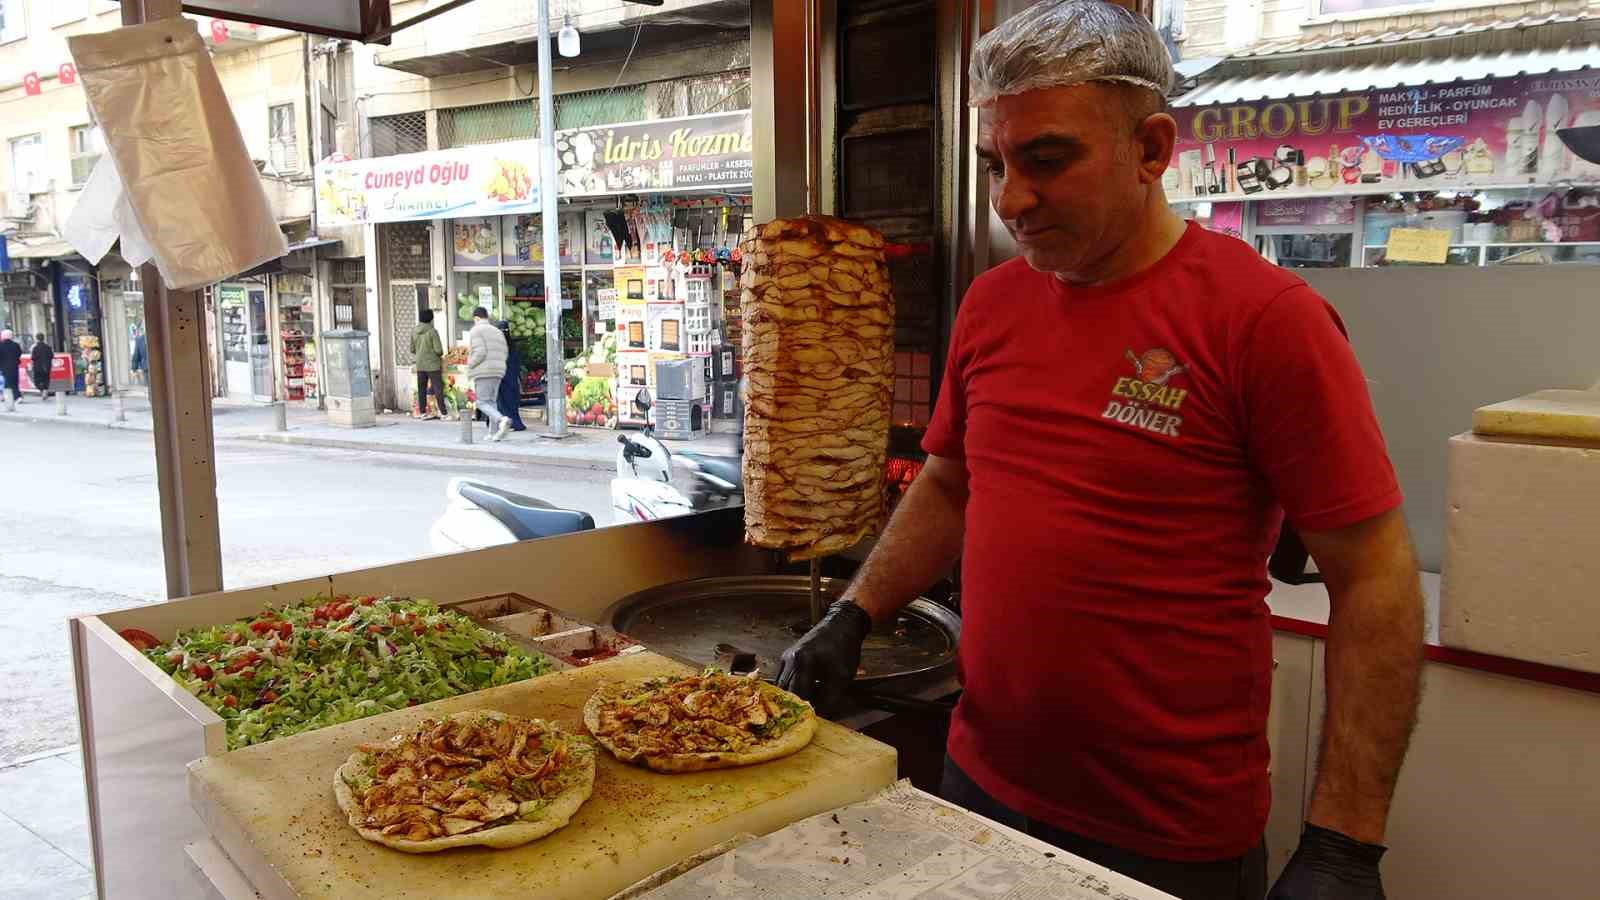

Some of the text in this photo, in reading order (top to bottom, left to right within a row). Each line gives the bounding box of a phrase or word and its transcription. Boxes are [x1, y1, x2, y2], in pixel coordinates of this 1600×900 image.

[1379, 84, 1492, 103] MAKYAJ PARFÜM
[1192, 96, 1370, 143] GROUP
[1378, 97, 1517, 117] HEDİYELİK OYUNCAK
[1378, 112, 1469, 130] EV GEREÇLERİ
[604, 129, 663, 163] İdris
[429, 160, 470, 186] Oğlu
[676, 174, 703, 183] MAKYAJ
[708, 170, 738, 181] PLASTİK
[1112, 377, 1188, 410] ESSAH
[1101, 400, 1183, 437] DÖNER
